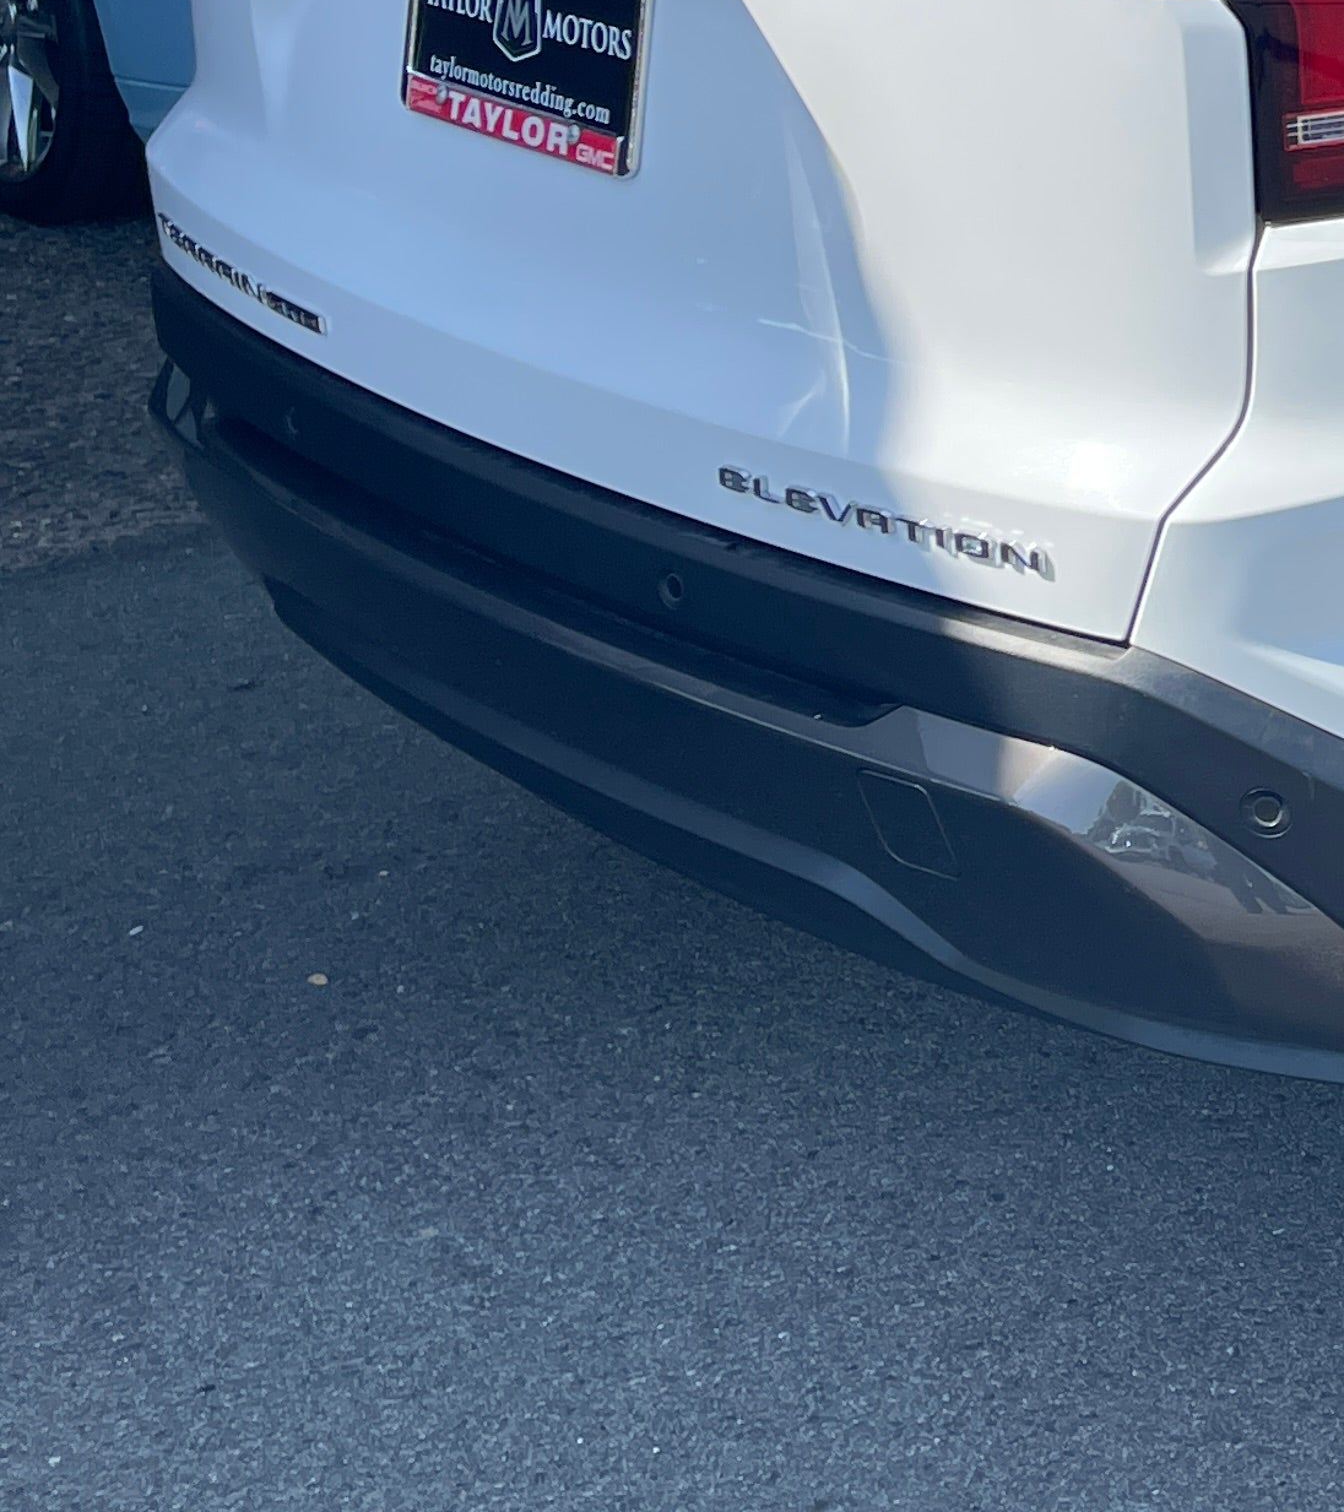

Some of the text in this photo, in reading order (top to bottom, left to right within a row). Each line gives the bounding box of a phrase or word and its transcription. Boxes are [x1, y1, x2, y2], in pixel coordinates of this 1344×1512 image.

[542, 10, 633, 61] MOTORS
[429, 53, 611, 125] taylormotorsredding.com
[449, 93, 571, 156] TAYLOR
[575, 142, 614, 171] GMC
[716, 463, 1055, 582] ELEVATION
